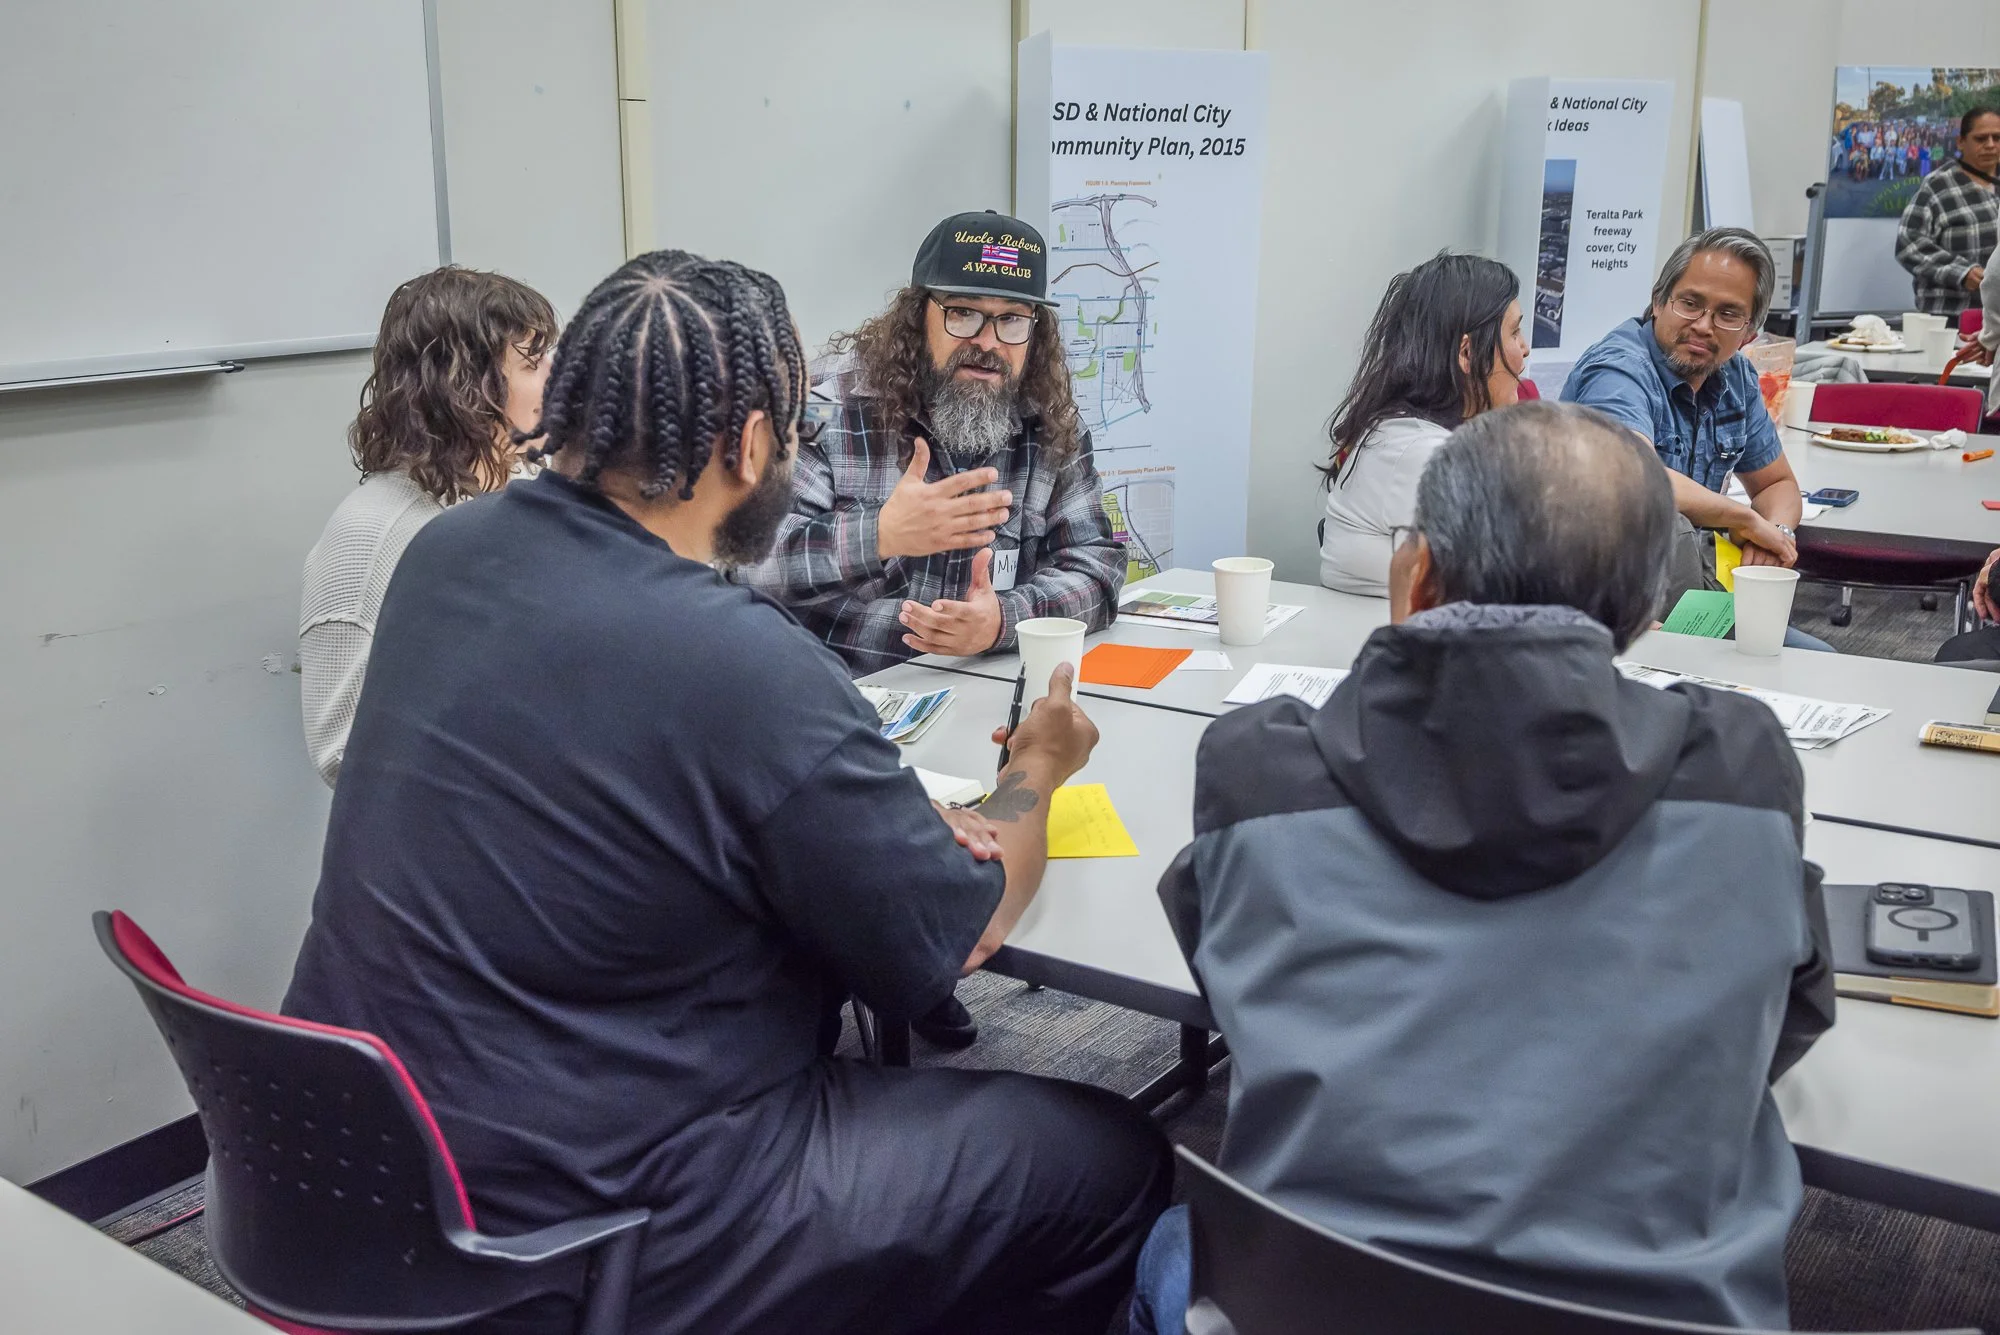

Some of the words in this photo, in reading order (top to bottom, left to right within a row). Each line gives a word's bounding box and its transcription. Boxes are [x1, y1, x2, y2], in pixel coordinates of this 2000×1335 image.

[1550, 96, 1559, 109] &
[1562, 97, 1619, 110] National
[1621, 97, 1648, 113] City
[1053, 102, 1080, 121] SD
[1085, 102, 1098, 121] &
[1103, 102, 1189, 122] National
[1193, 103, 1231, 128] City
[1554, 118, 1590, 131] Ideas
[1148, 136, 1194, 160] Plan,
[1199, 137, 1246, 156] 2015
[1586, 210, 1620, 220] Teralta
[1622, 209, 1643, 220] Park
[955, 231, 994, 244] Uncle
[1593, 226, 1633, 239] freeway
[1586, 243, 1615, 254] cover,
[1617, 242, 1637, 255] City
[962, 261, 997, 274] AWA
[1001, 265, 1032, 279] CLUB
[1591, 258, 1629, 271] Heights
